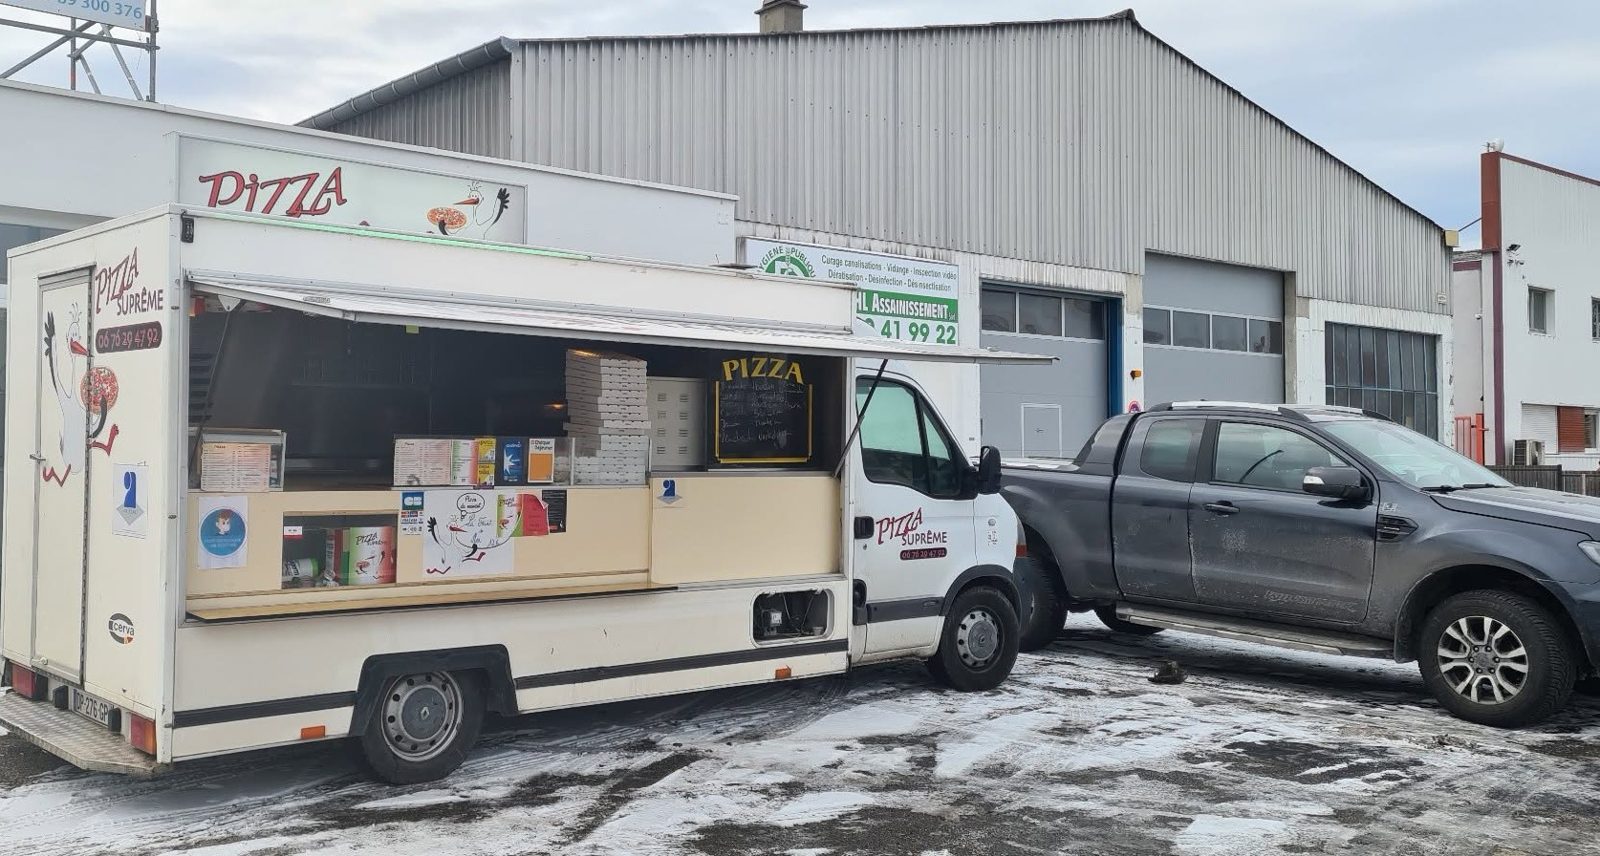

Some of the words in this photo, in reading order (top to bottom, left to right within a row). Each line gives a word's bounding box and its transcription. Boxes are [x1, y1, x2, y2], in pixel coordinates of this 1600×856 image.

[115, 3, 142, 19] 376
[757, 245, 784, 271] YGIENE
[821, 254, 843, 268] Curage
[844, 259, 882, 271] canalisations
[886, 262, 909, 276] Vidange
[913, 267, 941, 278] Inspection
[117, 286, 163, 316] SUPRÊME
[98, 330, 109, 349] 06
[122, 331, 133, 349] 29
[134, 329, 146, 348] 47
[881, 319, 900, 340] 41
[908, 321, 930, 343] 99
[935, 324, 956, 345] 22
[723, 357, 804, 385] PIZZA
[901, 530, 948, 546] SUPRÊME
[113, 622, 135, 636] cerva
